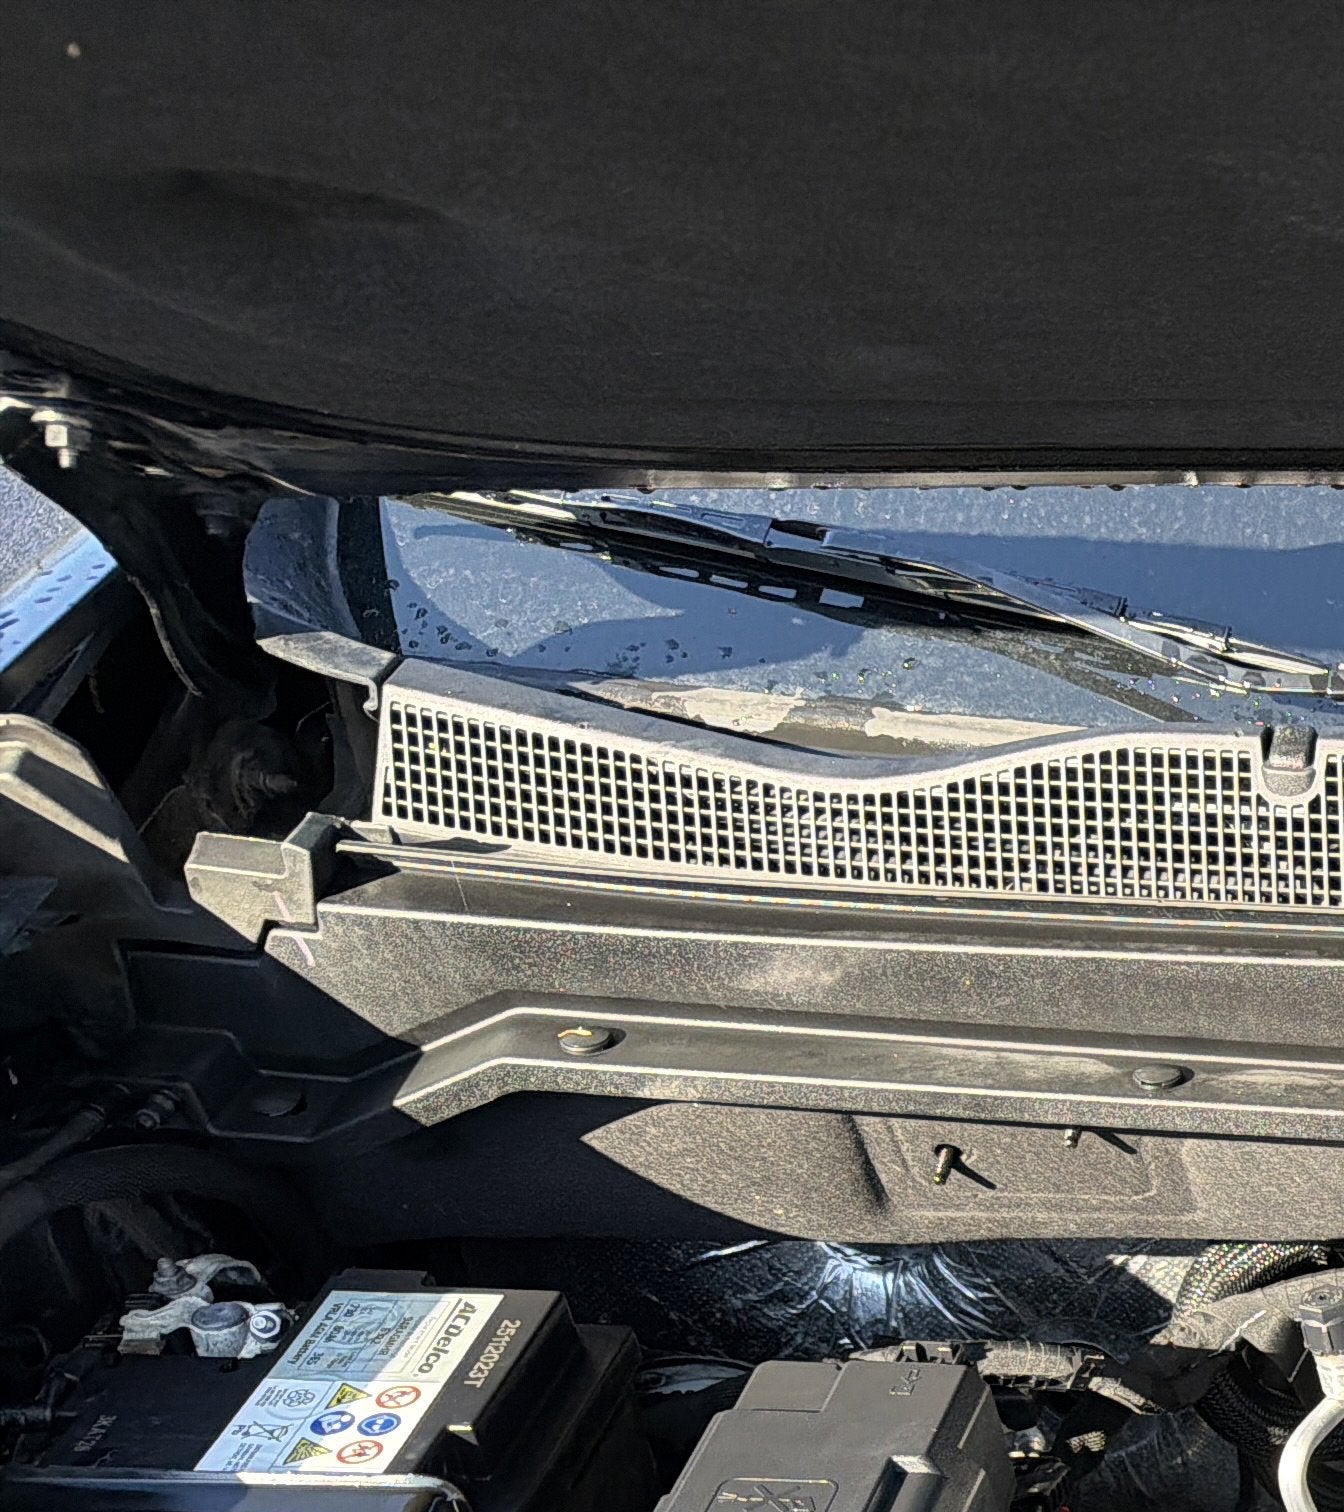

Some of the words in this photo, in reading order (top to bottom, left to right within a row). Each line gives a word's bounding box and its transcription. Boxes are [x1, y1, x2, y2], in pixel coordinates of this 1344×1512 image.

[287, 1339, 316, 1365] Battery
[417, 1301, 478, 1374] ACDelco
[464, 1319, 522, 1389] 25112023T
